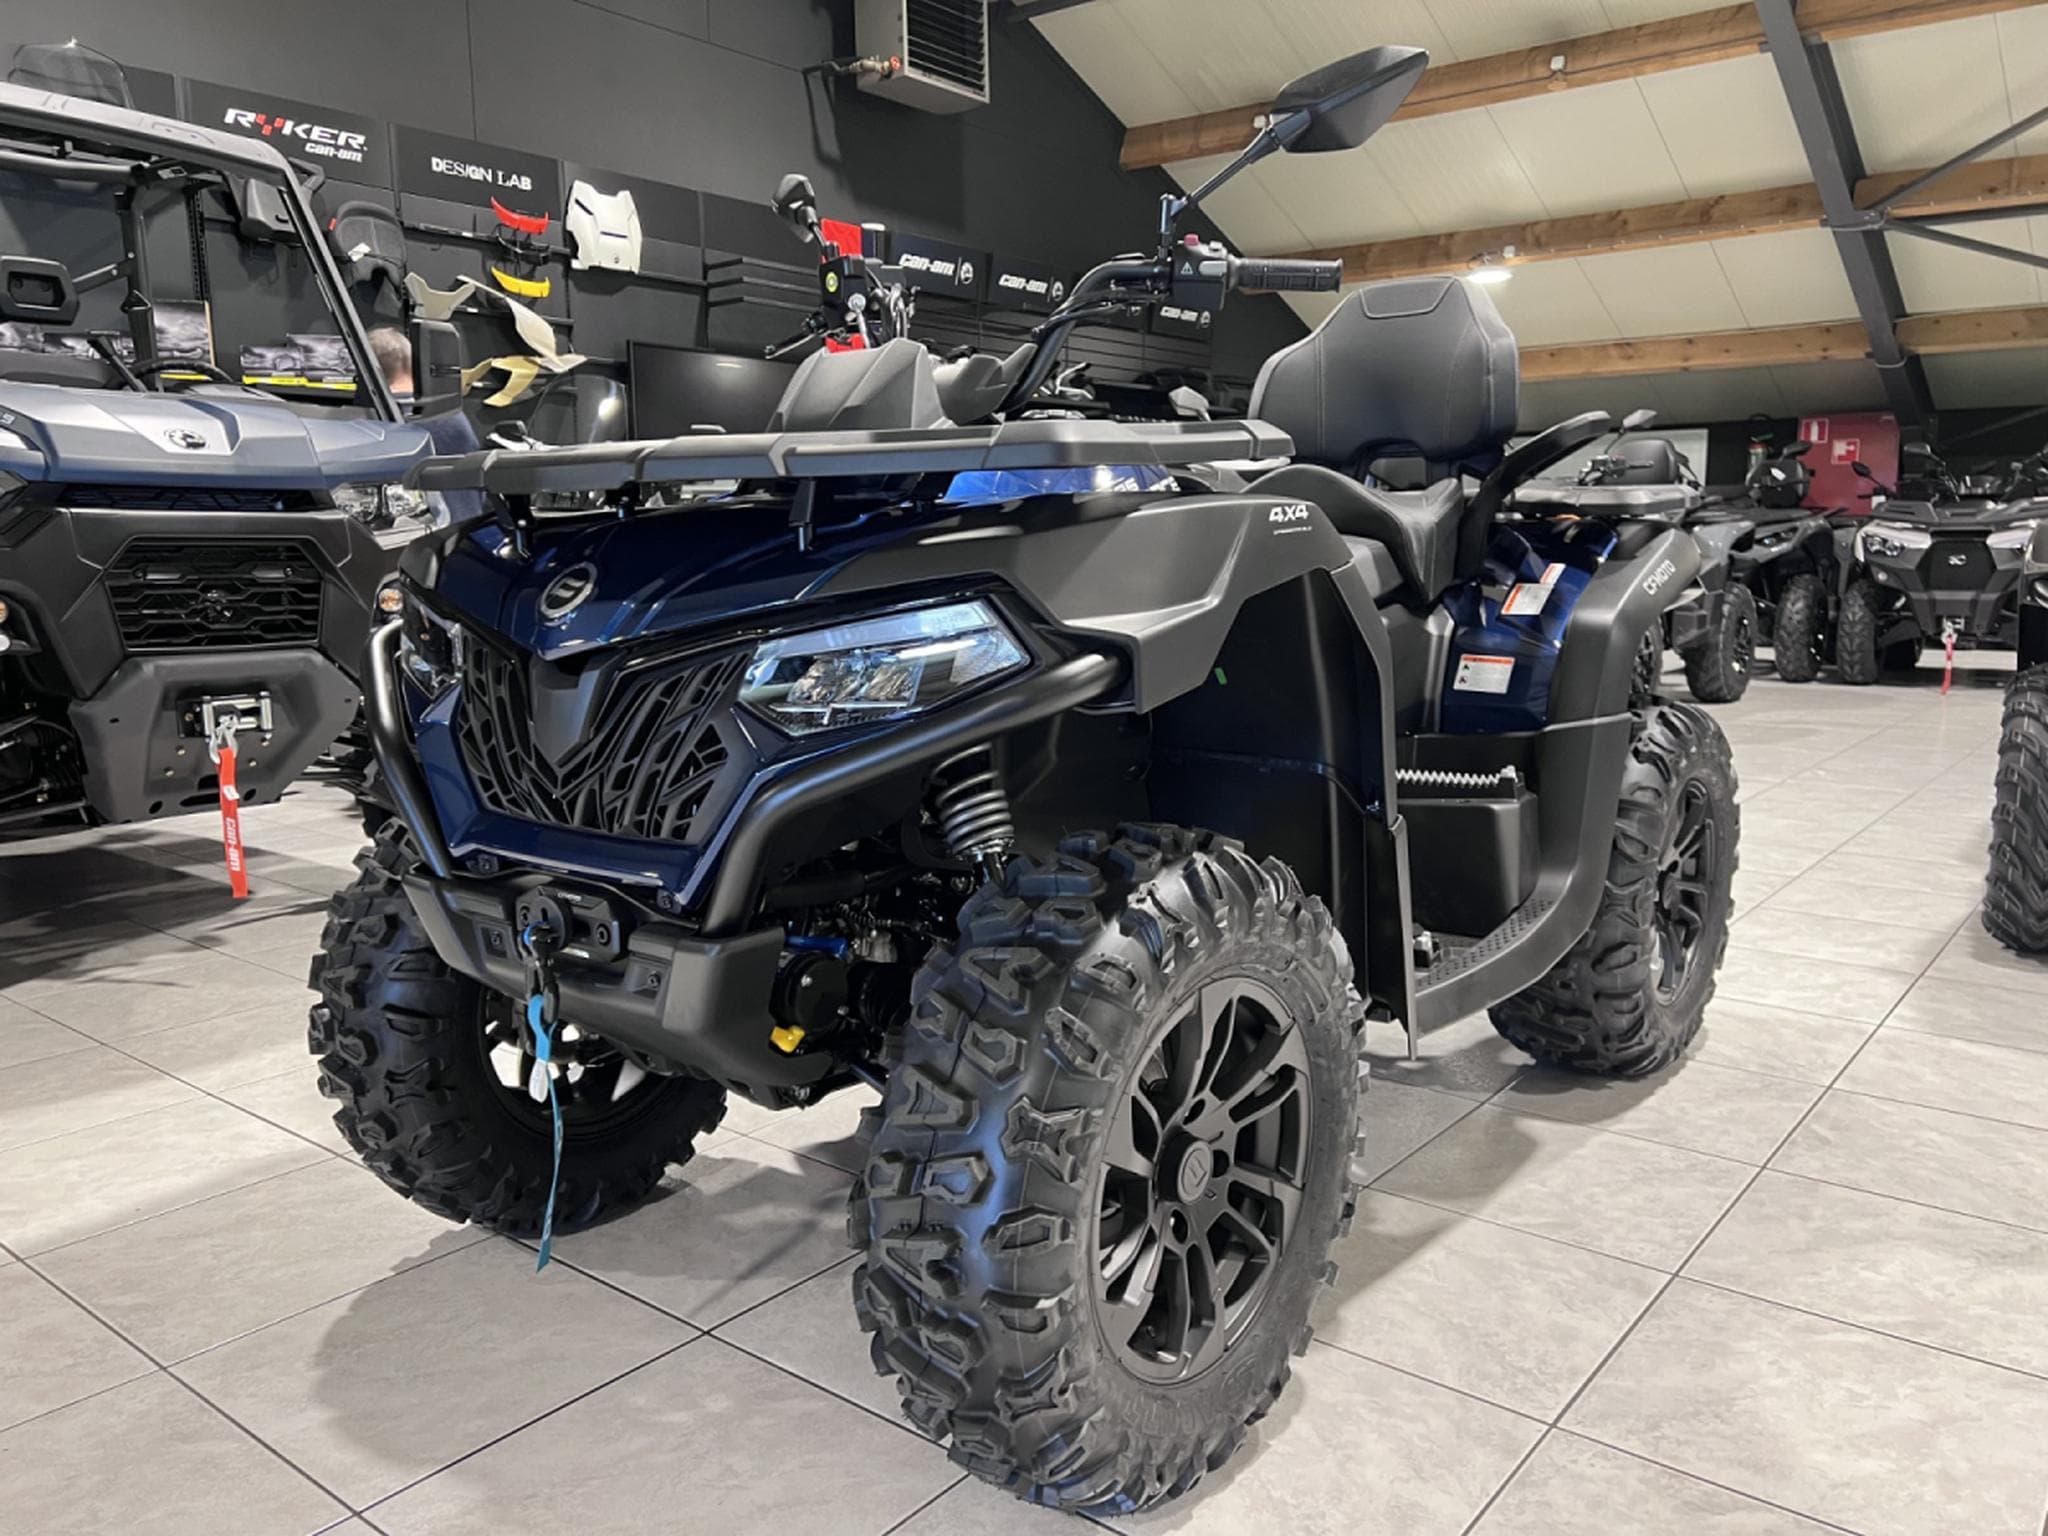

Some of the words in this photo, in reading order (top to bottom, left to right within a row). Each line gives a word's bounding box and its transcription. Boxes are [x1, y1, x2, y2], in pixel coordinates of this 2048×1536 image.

[224, 108, 366, 148] RYKER
[305, 142, 363, 162] can-am
[431, 157, 492, 183] DESIGN
[496, 170, 532, 191] LAB
[899, 253, 954, 277] can-am
[999, 274, 1048, 295] can-am
[1643, 559, 1676, 595] CFMOTO
